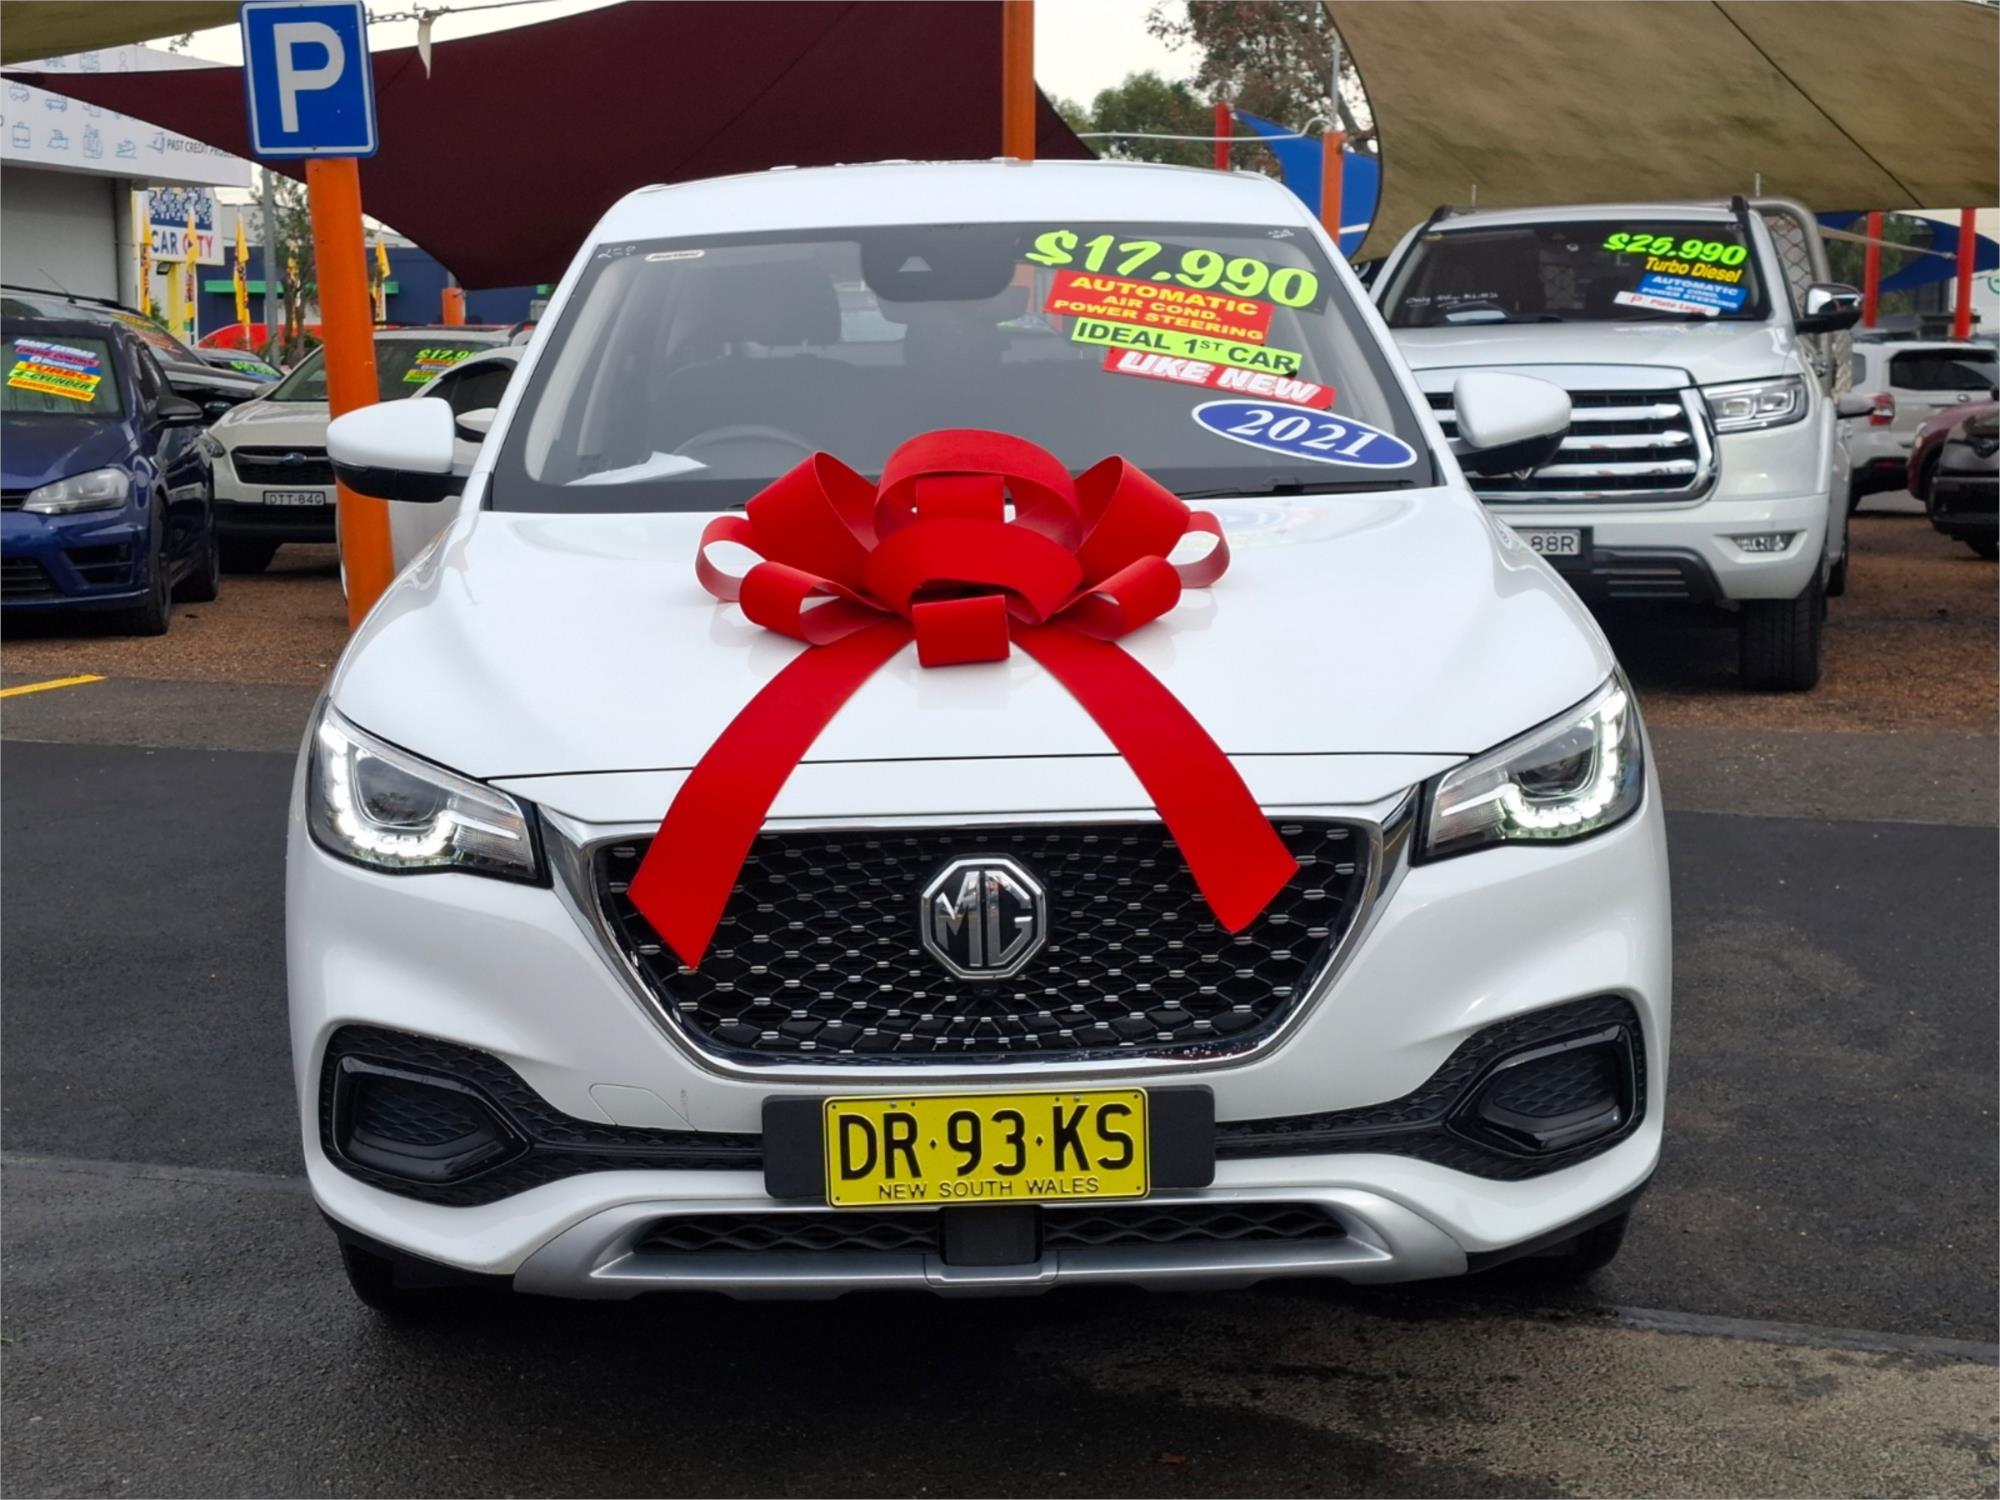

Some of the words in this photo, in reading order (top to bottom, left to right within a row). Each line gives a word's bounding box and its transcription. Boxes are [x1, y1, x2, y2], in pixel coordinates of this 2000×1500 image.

[272, 21, 346, 134] P
[151, 230, 179, 255] CAR
[182, 233, 213, 258] CTY
[1603, 232, 1748, 266] $25.990
[1025, 229, 1319, 308] $17.990
[1645, 257, 1690, 275] Turbo
[1691, 263, 1743, 283] Diesel
[1651, 275, 1739, 296] AUTOMATIC
[1070, 276, 1259, 316] AUTOMATIC
[1103, 295, 1144, 309] AIR
[1054, 299, 1138, 320] POWER
[1144, 312, 1265, 341] STEERING
[1077, 322, 1171, 350] IDEAL
[1228, 346, 1296, 373] CAR
[25, 363, 92, 381] TURBO
[1117, 350, 1214, 383] LIKE
[1216, 367, 1322, 404] NEW
[1226, 409, 1379, 458] 2021
[935, 870, 1034, 967] MG
[878, 1183, 928, 1199] NEW
[939, 1180, 1012, 1198] SOUTH
[1026, 1177, 1099, 1194] WALES
